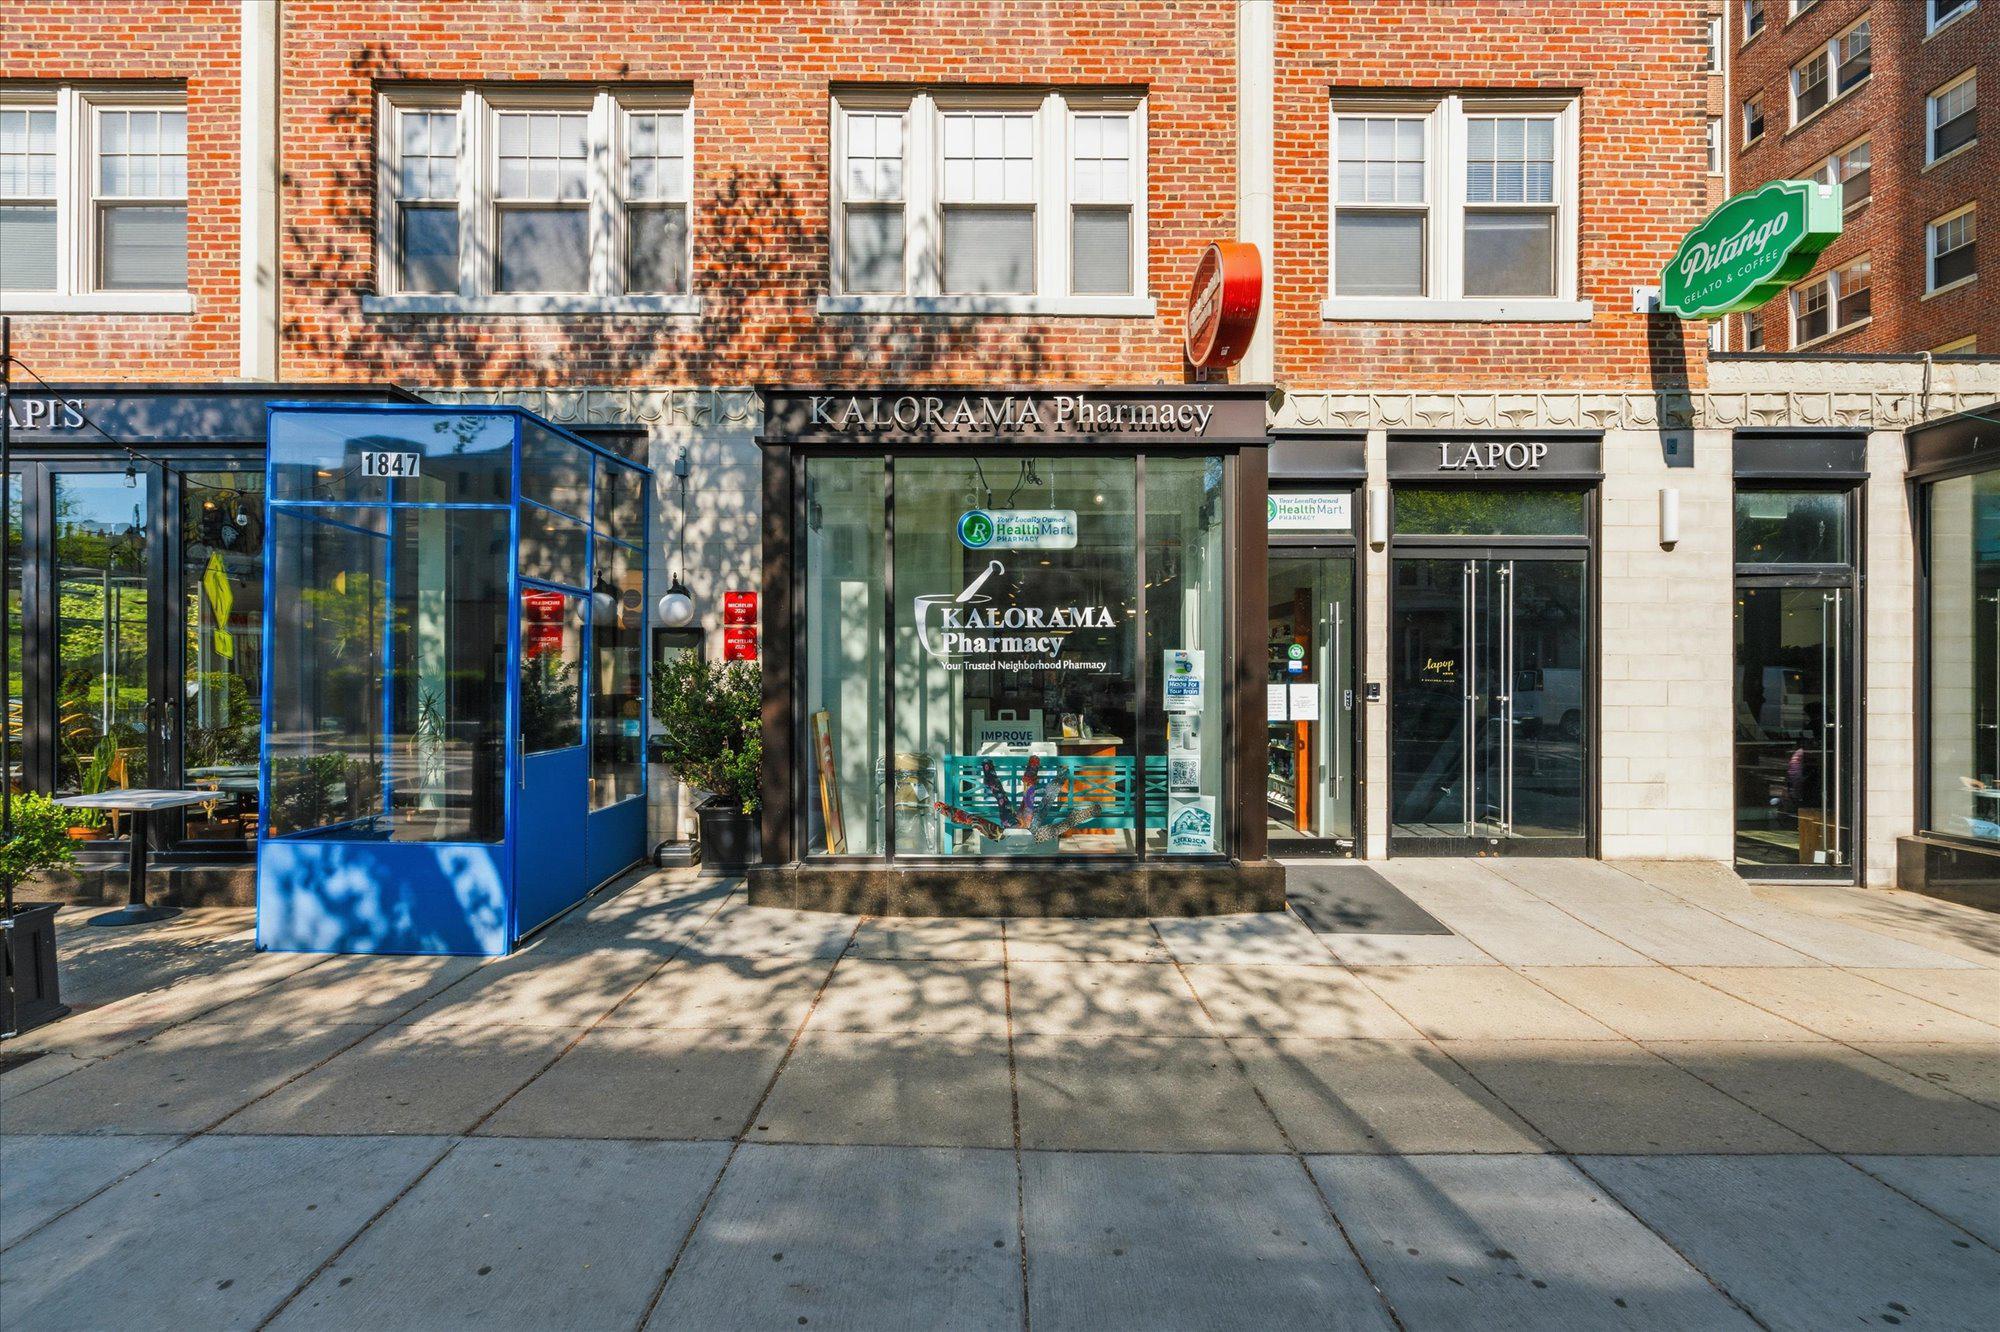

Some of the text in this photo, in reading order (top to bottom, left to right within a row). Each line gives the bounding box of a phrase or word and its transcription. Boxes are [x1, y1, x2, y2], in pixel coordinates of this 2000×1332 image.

[1680, 211, 1789, 288] Pitango
[1684, 249, 1779, 305] GELATO & COFFEE
[808, 394, 1214, 432] KALORAMA Pharmacy
[365, 453, 418, 476] 1847
[1439, 442, 1548, 469] LAPOP
[997, 516, 1013, 524] Your
[1015, 516, 1041, 525] Locally
[941, 606, 1117, 629] KALORAMA
[941, 632, 1065, 658] Pharmacy
[941, 660, 1107, 673] Your Trusted Neighborhood Pharmacy
[981, 731, 1033, 740] IMPROVE
